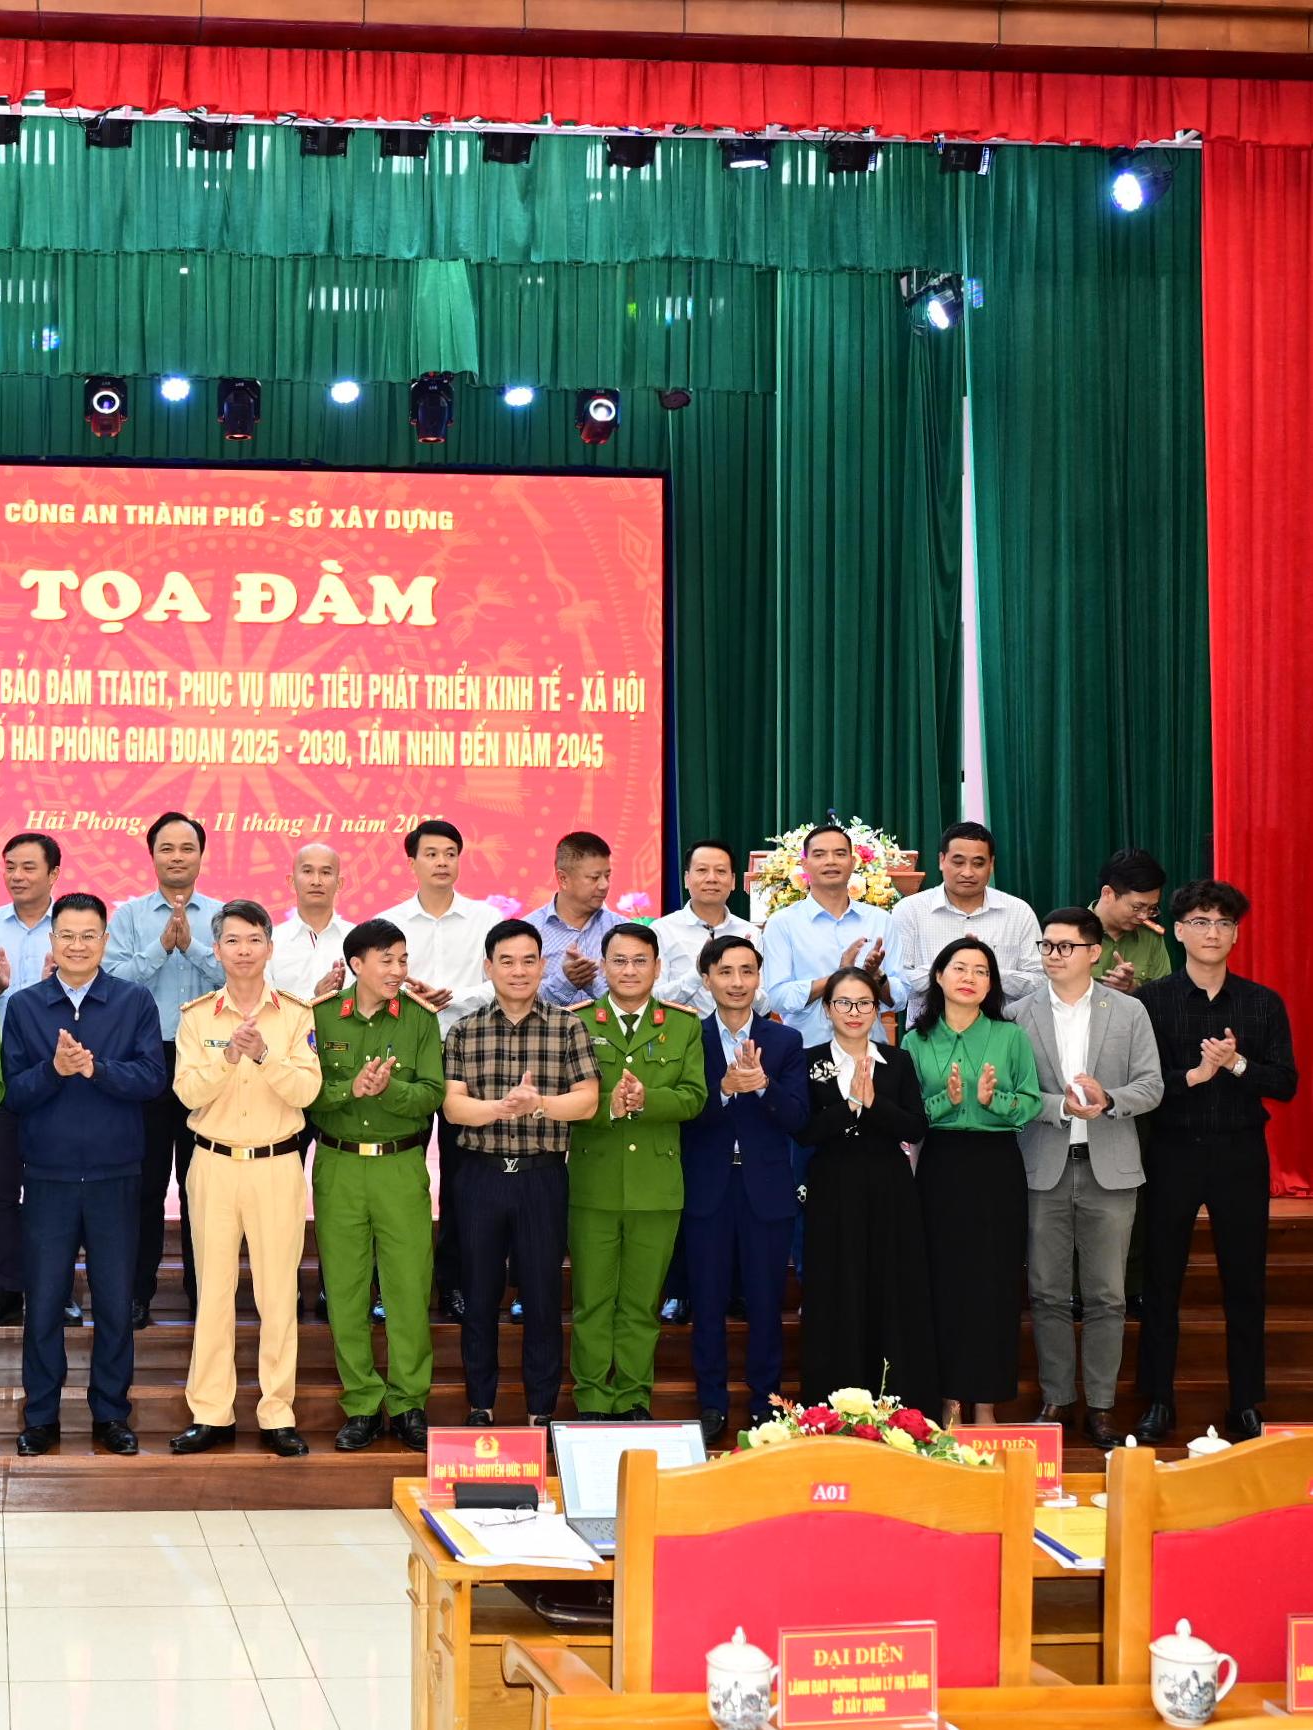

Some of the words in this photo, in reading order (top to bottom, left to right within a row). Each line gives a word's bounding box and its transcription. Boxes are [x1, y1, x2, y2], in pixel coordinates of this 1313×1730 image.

[5, 499, 75, 524] CÔNG
[82, 505, 117, 524] AN
[124, 499, 207, 526] THÀNH
[214, 499, 265, 527] PHỐ
[289, 501, 323, 528] SỞ
[330, 503, 379, 529] XÂY
[385, 508, 453, 534] DỰNG
[20, 569, 211, 634] TỌA
[233, 559, 437, 626] ĐÀM
[0, 653, 40, 705] BẢO
[46, 654, 91, 705] ĐẢM
[97, 670, 173, 712] TTATGT,
[180, 671, 233, 715] PHỤC
[238, 671, 264, 716] VỤ
[269, 672, 315, 716] MỤC
[320, 666, 363, 709] TIÊU
[368, 666, 419, 709] PHÁT
[424, 660, 481, 711] TRIỂN
[486, 675, 533, 712] KINH
[538, 664, 563, 712] TẾ
[581, 670, 607, 713] XÃ
[612, 670, 645, 721] HỘI
[11, 710, 45, 762] HẢI
[50, 716, 119, 762] PHÒNG
[125, 727, 166, 763] GIAI
[170, 727, 225, 772] ĐOẠN
[230, 729, 279, 765] 2025
[298, 730, 352, 769] 2030,
[358, 717, 400, 766] TẦM
[406, 723, 455, 767] NHÌN
[460, 718, 500, 767] ĐẾN
[505, 724, 551, 768] NĂM
[556, 732, 604, 769] 2045
[25, 810, 67, 830] Hải
[71, 811, 147, 836] Phòng,
[213, 812, 237, 832] 11
[242, 813, 304, 837] tháng
[311, 813, 334, 833] 11
[340, 814, 387, 833] năm
[475, 1459, 505, 1478] NGUYỄN
[813, 1485, 846, 1500] A01
[814, 1648, 849, 1670] ĐẠI
[855, 1642, 903, 1668] DIỆN
